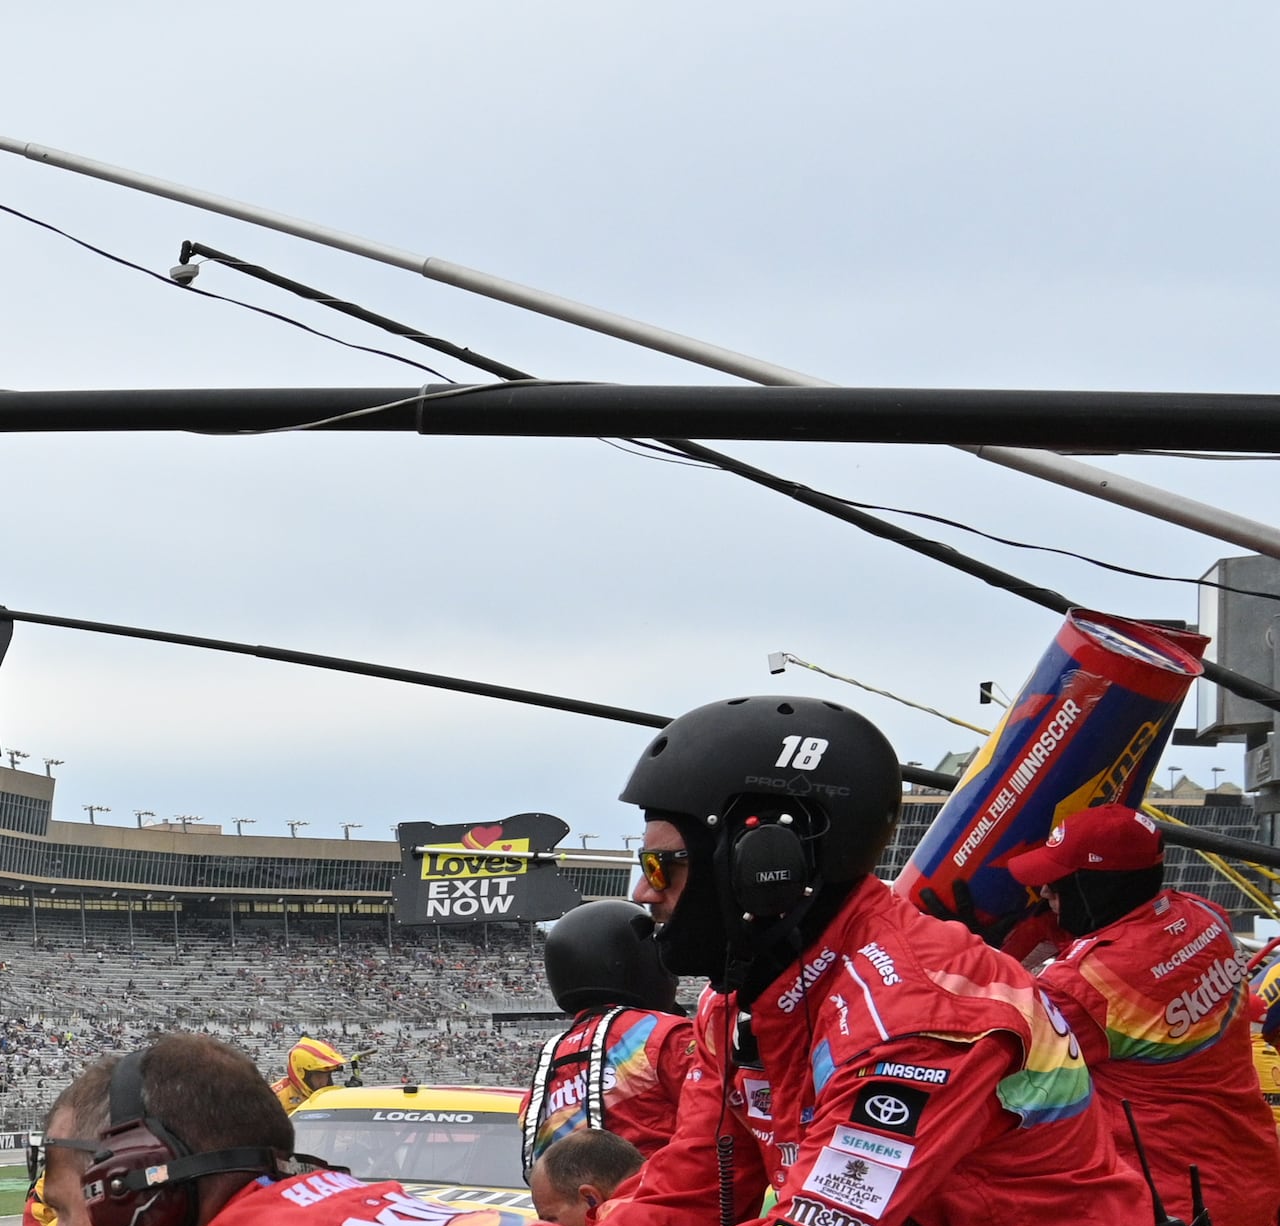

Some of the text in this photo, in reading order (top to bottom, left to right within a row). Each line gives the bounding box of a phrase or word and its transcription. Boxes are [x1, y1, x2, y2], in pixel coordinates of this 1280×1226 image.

[1025, 699, 1081, 776] NASCAR
[775, 735, 829, 771] 18
[953, 788, 1014, 868] OFFICIAL FUEL
[759, 870, 788, 882] NATE
[429, 877, 516, 898] EXIT
[427, 896, 514, 917] NOW
[1165, 950, 1249, 1038] Skittles
[882, 1063, 946, 1084] NASCAR
[373, 1111, 474, 1123] LOGANO
[841, 1135, 902, 1159] SIEMENS
[814, 1175, 878, 1204] HERITAGE
[826, 1173, 874, 1193] AMERICAN
